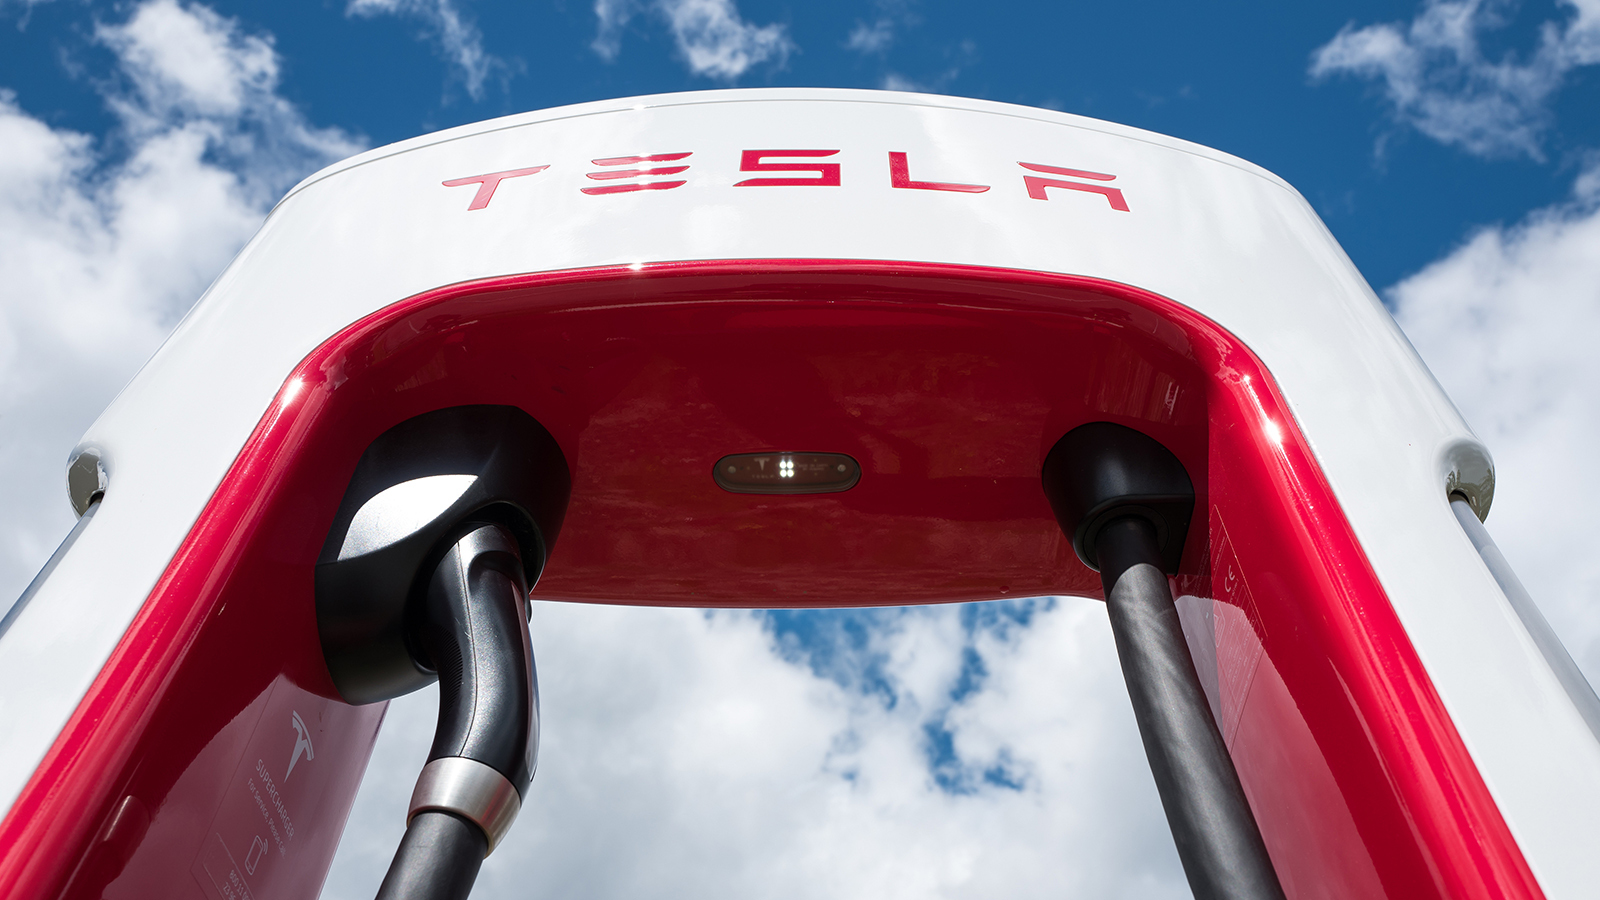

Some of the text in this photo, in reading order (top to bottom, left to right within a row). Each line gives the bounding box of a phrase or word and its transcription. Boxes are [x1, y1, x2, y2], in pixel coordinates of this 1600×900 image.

[442, 149, 1130, 212] TESLA
[1222, 565, 1235, 593] CE
[247, 778, 256, 793] For
[254, 790, 269, 823] Service,
[268, 818, 280, 844] Please
[256, 759, 295, 841] SUPERCHARGER
[229, 869, 239, 887] 800
